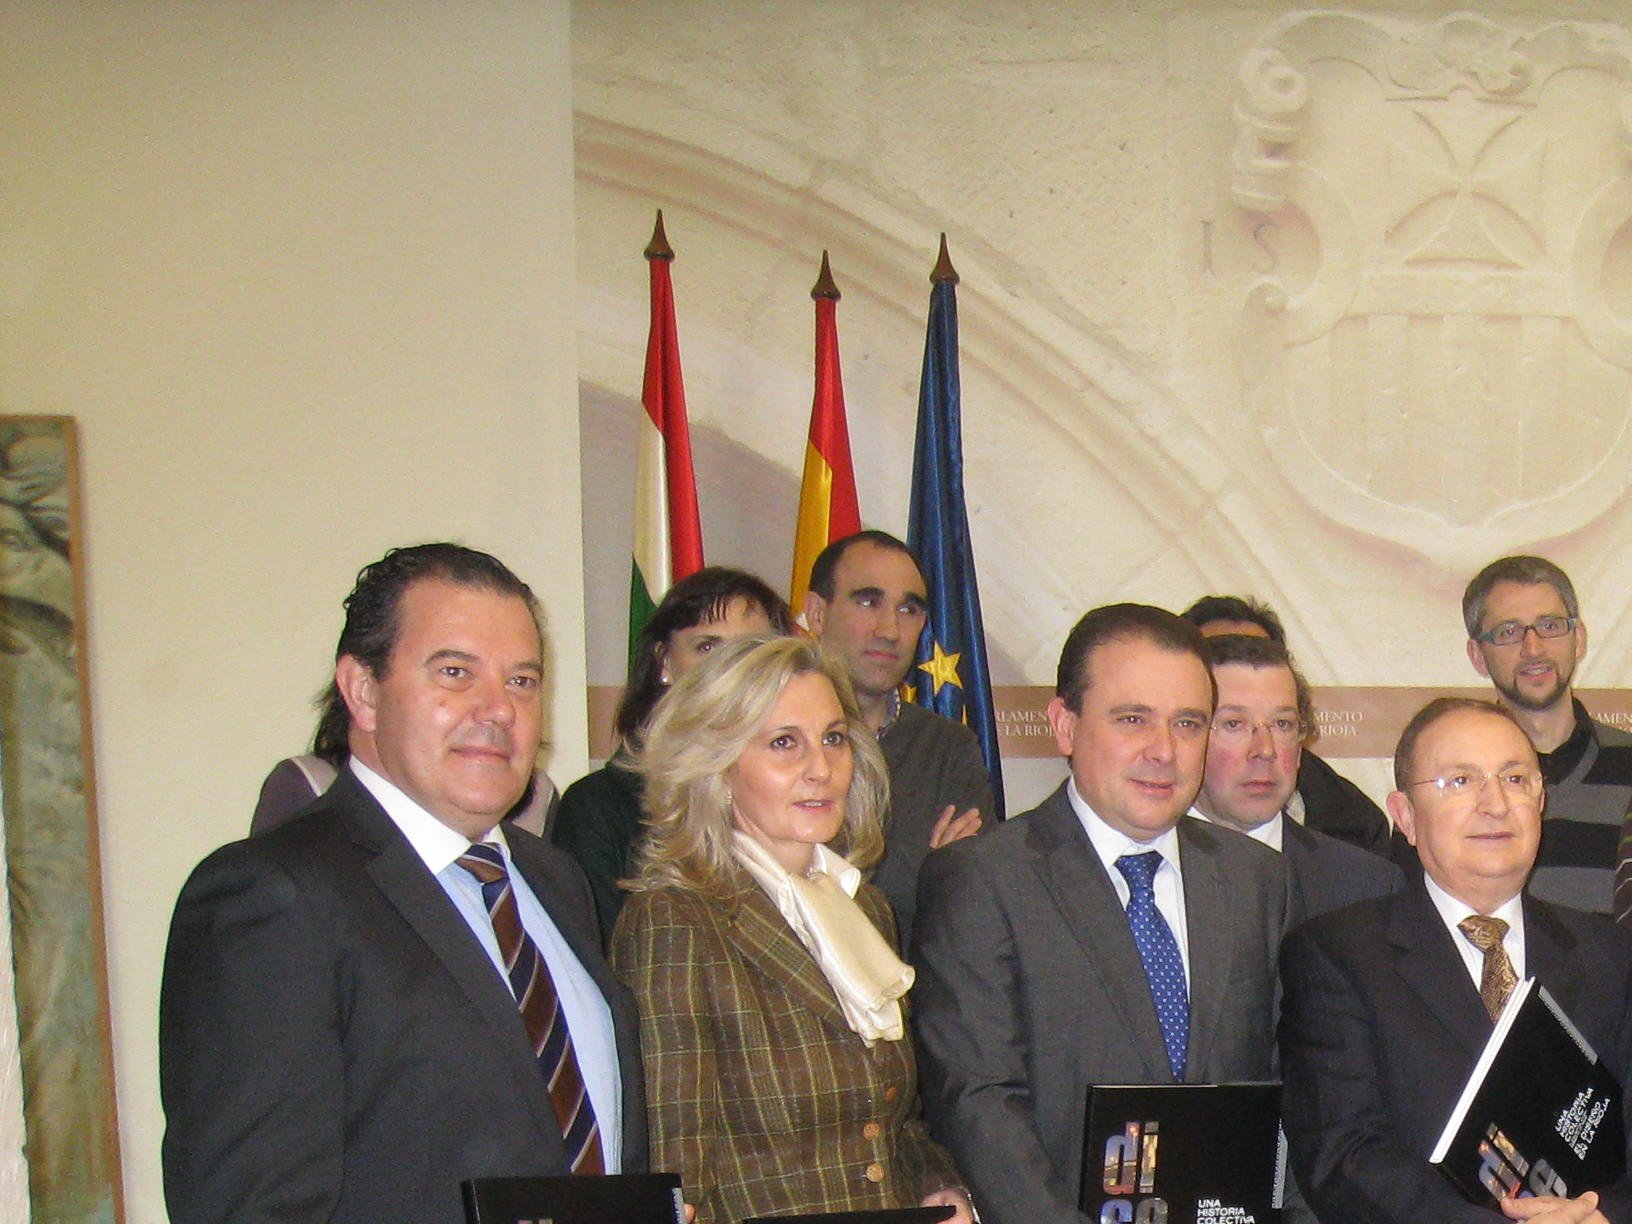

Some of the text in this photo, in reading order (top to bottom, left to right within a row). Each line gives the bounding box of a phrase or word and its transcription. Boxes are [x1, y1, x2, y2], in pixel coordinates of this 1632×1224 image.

[995, 711, 1048, 722] RLAMEN
[1024, 725, 1054, 737] RIOJ
[1198, 1199, 1221, 1208] UNA
[1197, 1207, 1246, 1217] HISTORIA
